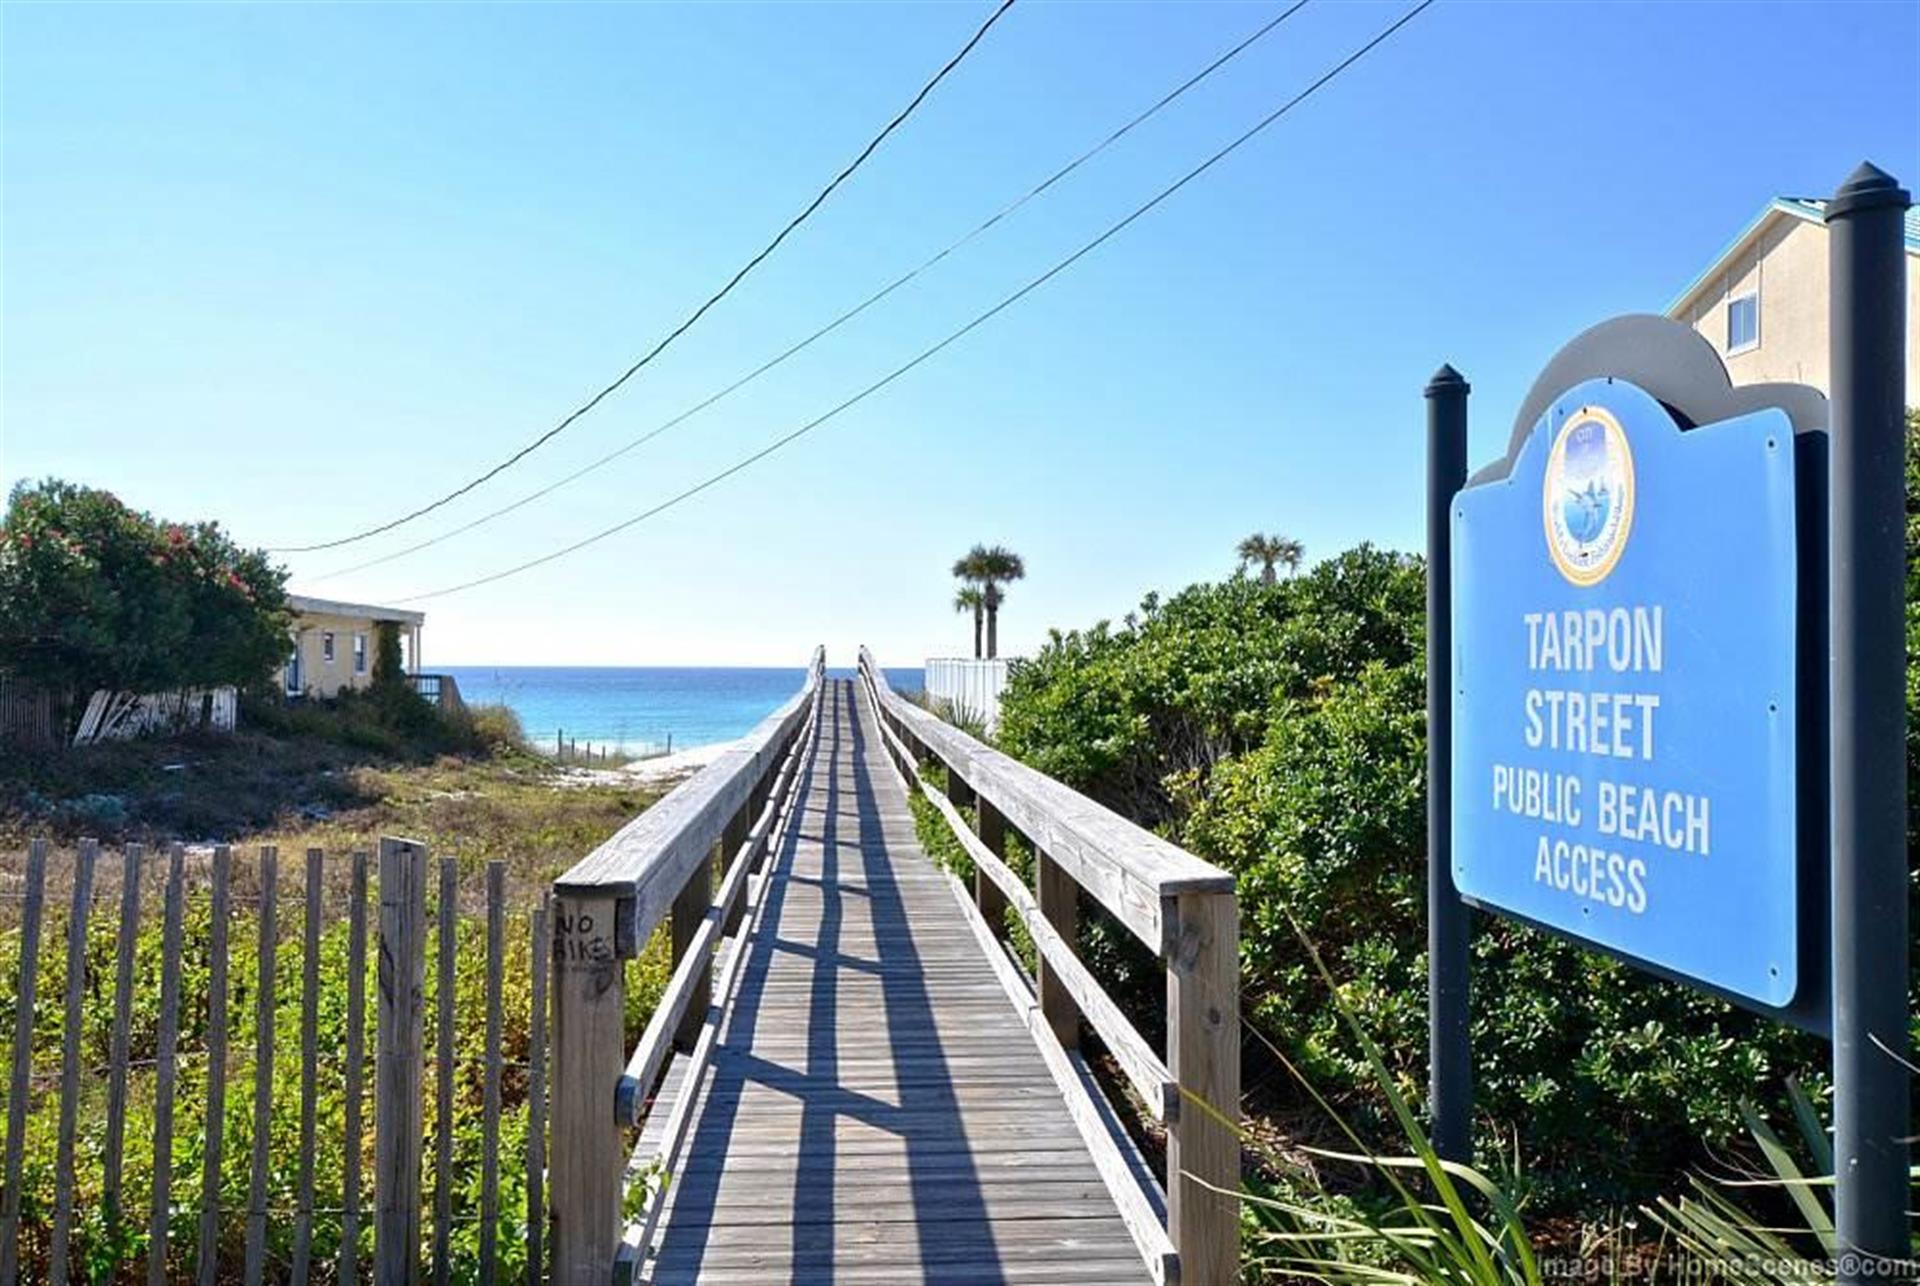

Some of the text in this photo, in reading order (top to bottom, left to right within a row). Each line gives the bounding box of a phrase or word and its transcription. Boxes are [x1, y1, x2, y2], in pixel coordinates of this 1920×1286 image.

[1524, 606, 1663, 672] TARPON
[1525, 689, 1660, 760] STREET
[1493, 764, 1709, 855] PUBLIC BEACH
[1535, 835, 1646, 914] ACCESS
[555, 915, 593, 935] NO
